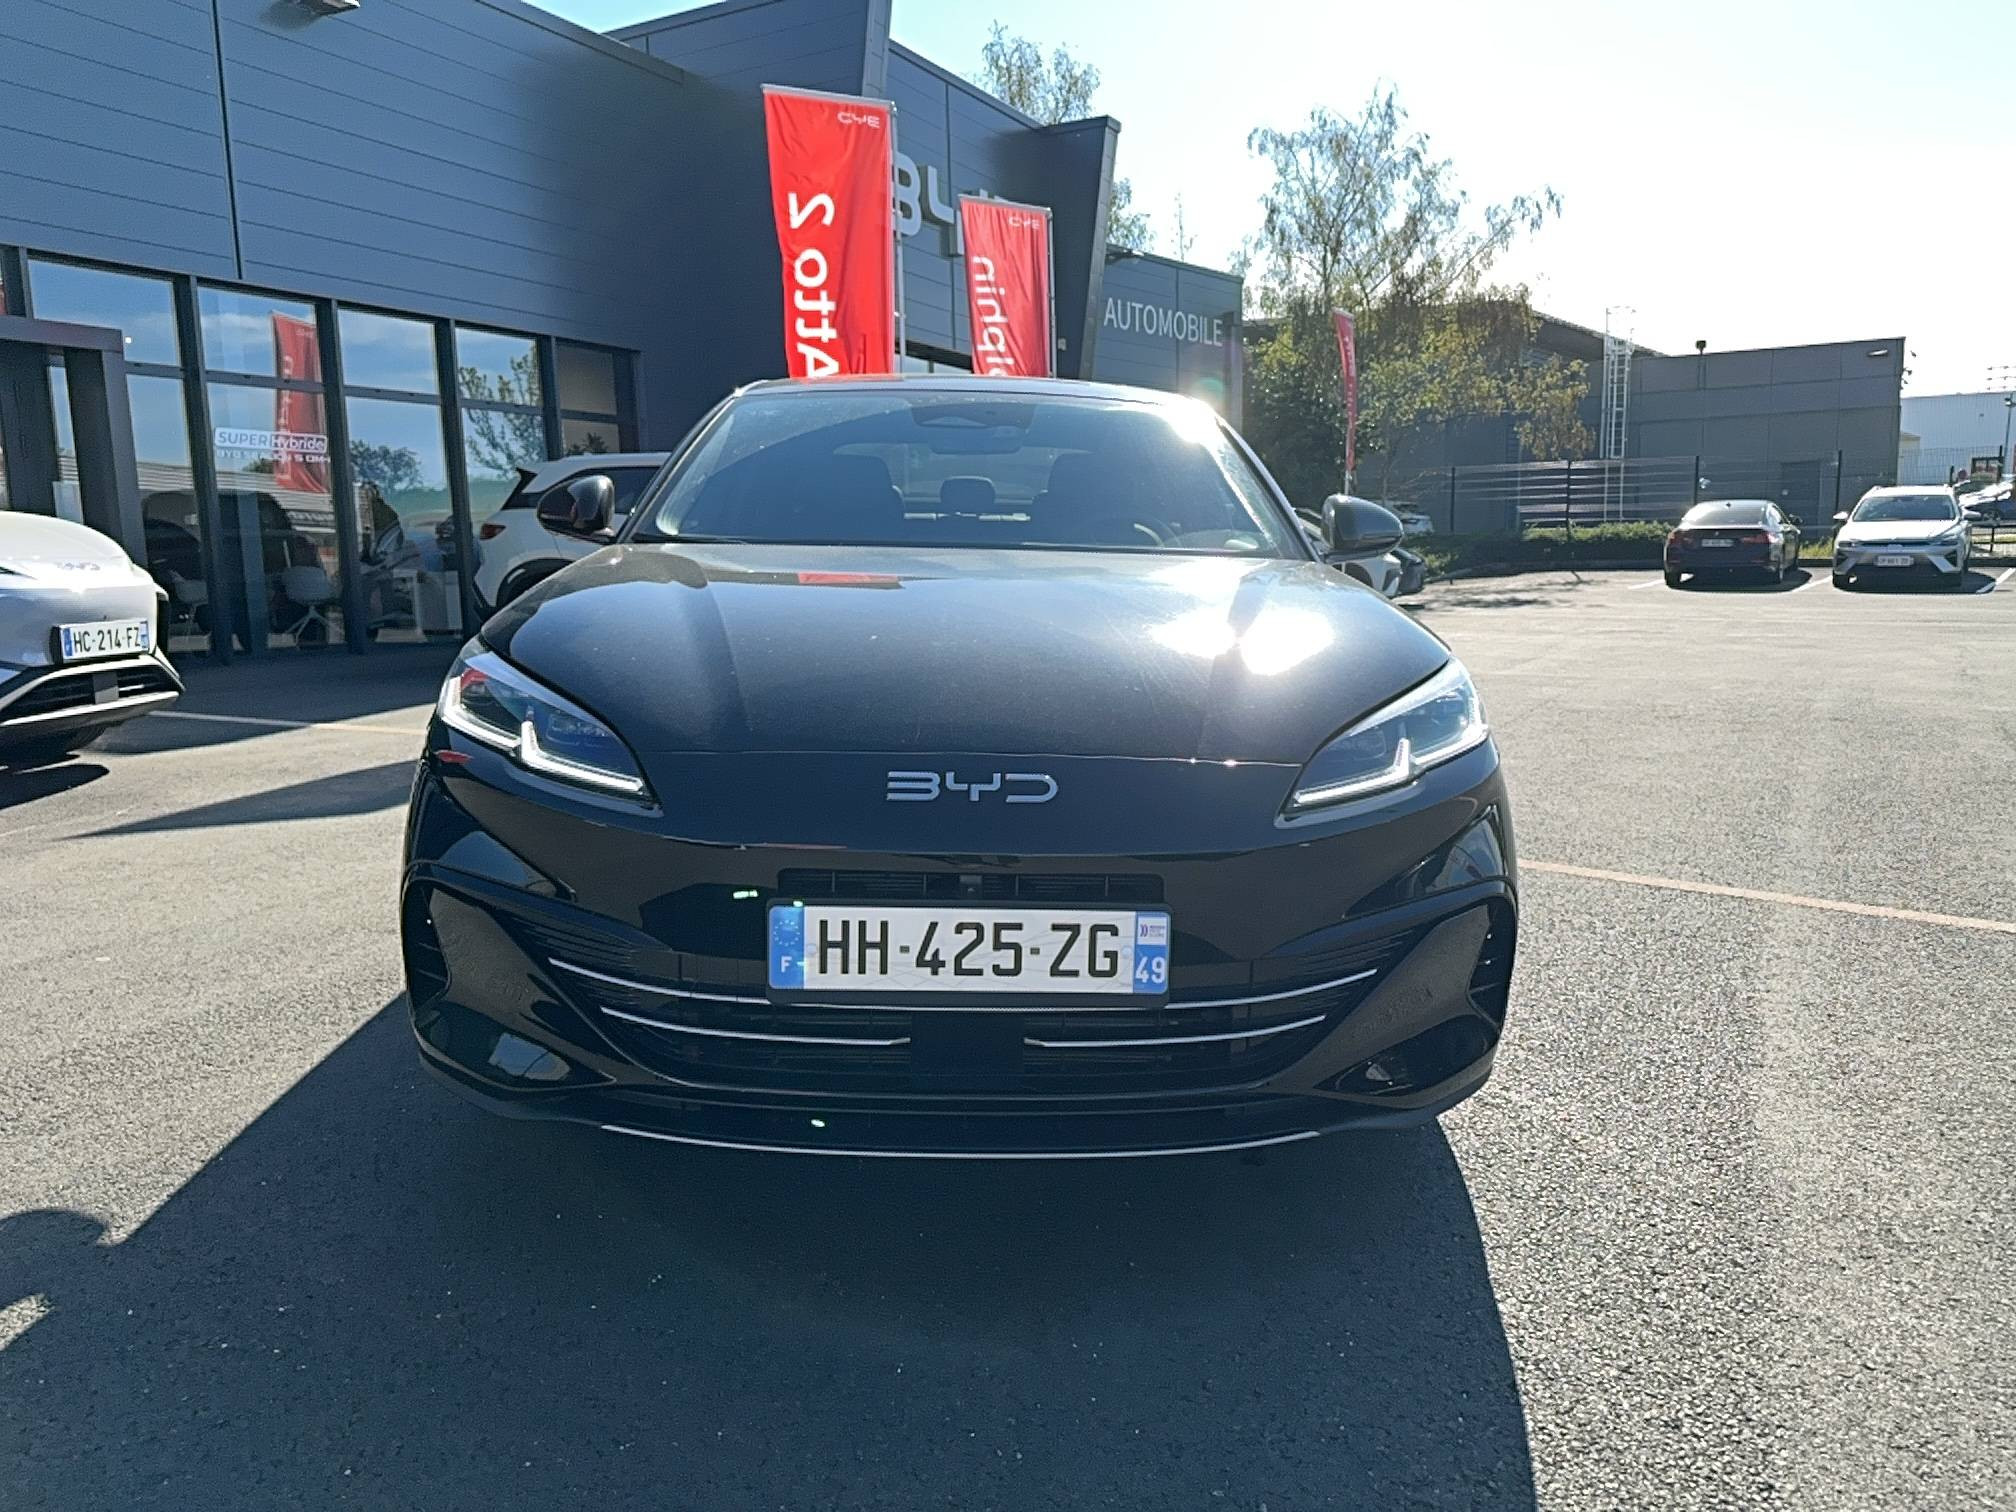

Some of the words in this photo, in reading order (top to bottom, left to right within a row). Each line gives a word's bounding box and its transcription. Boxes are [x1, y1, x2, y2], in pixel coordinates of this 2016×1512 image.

[1103, 297, 1223, 347] AUTOMOBILE
[219, 431, 267, 447] SUPER
[270, 434, 325, 451] Hybride
[73, 627, 140, 653] HC-214-FZ
[886, 771, 1059, 803] BYD
[818, 919, 1119, 978] HH-425-ZG
[781, 956, 792, 973] F
[1135, 956, 1166, 984] 49
